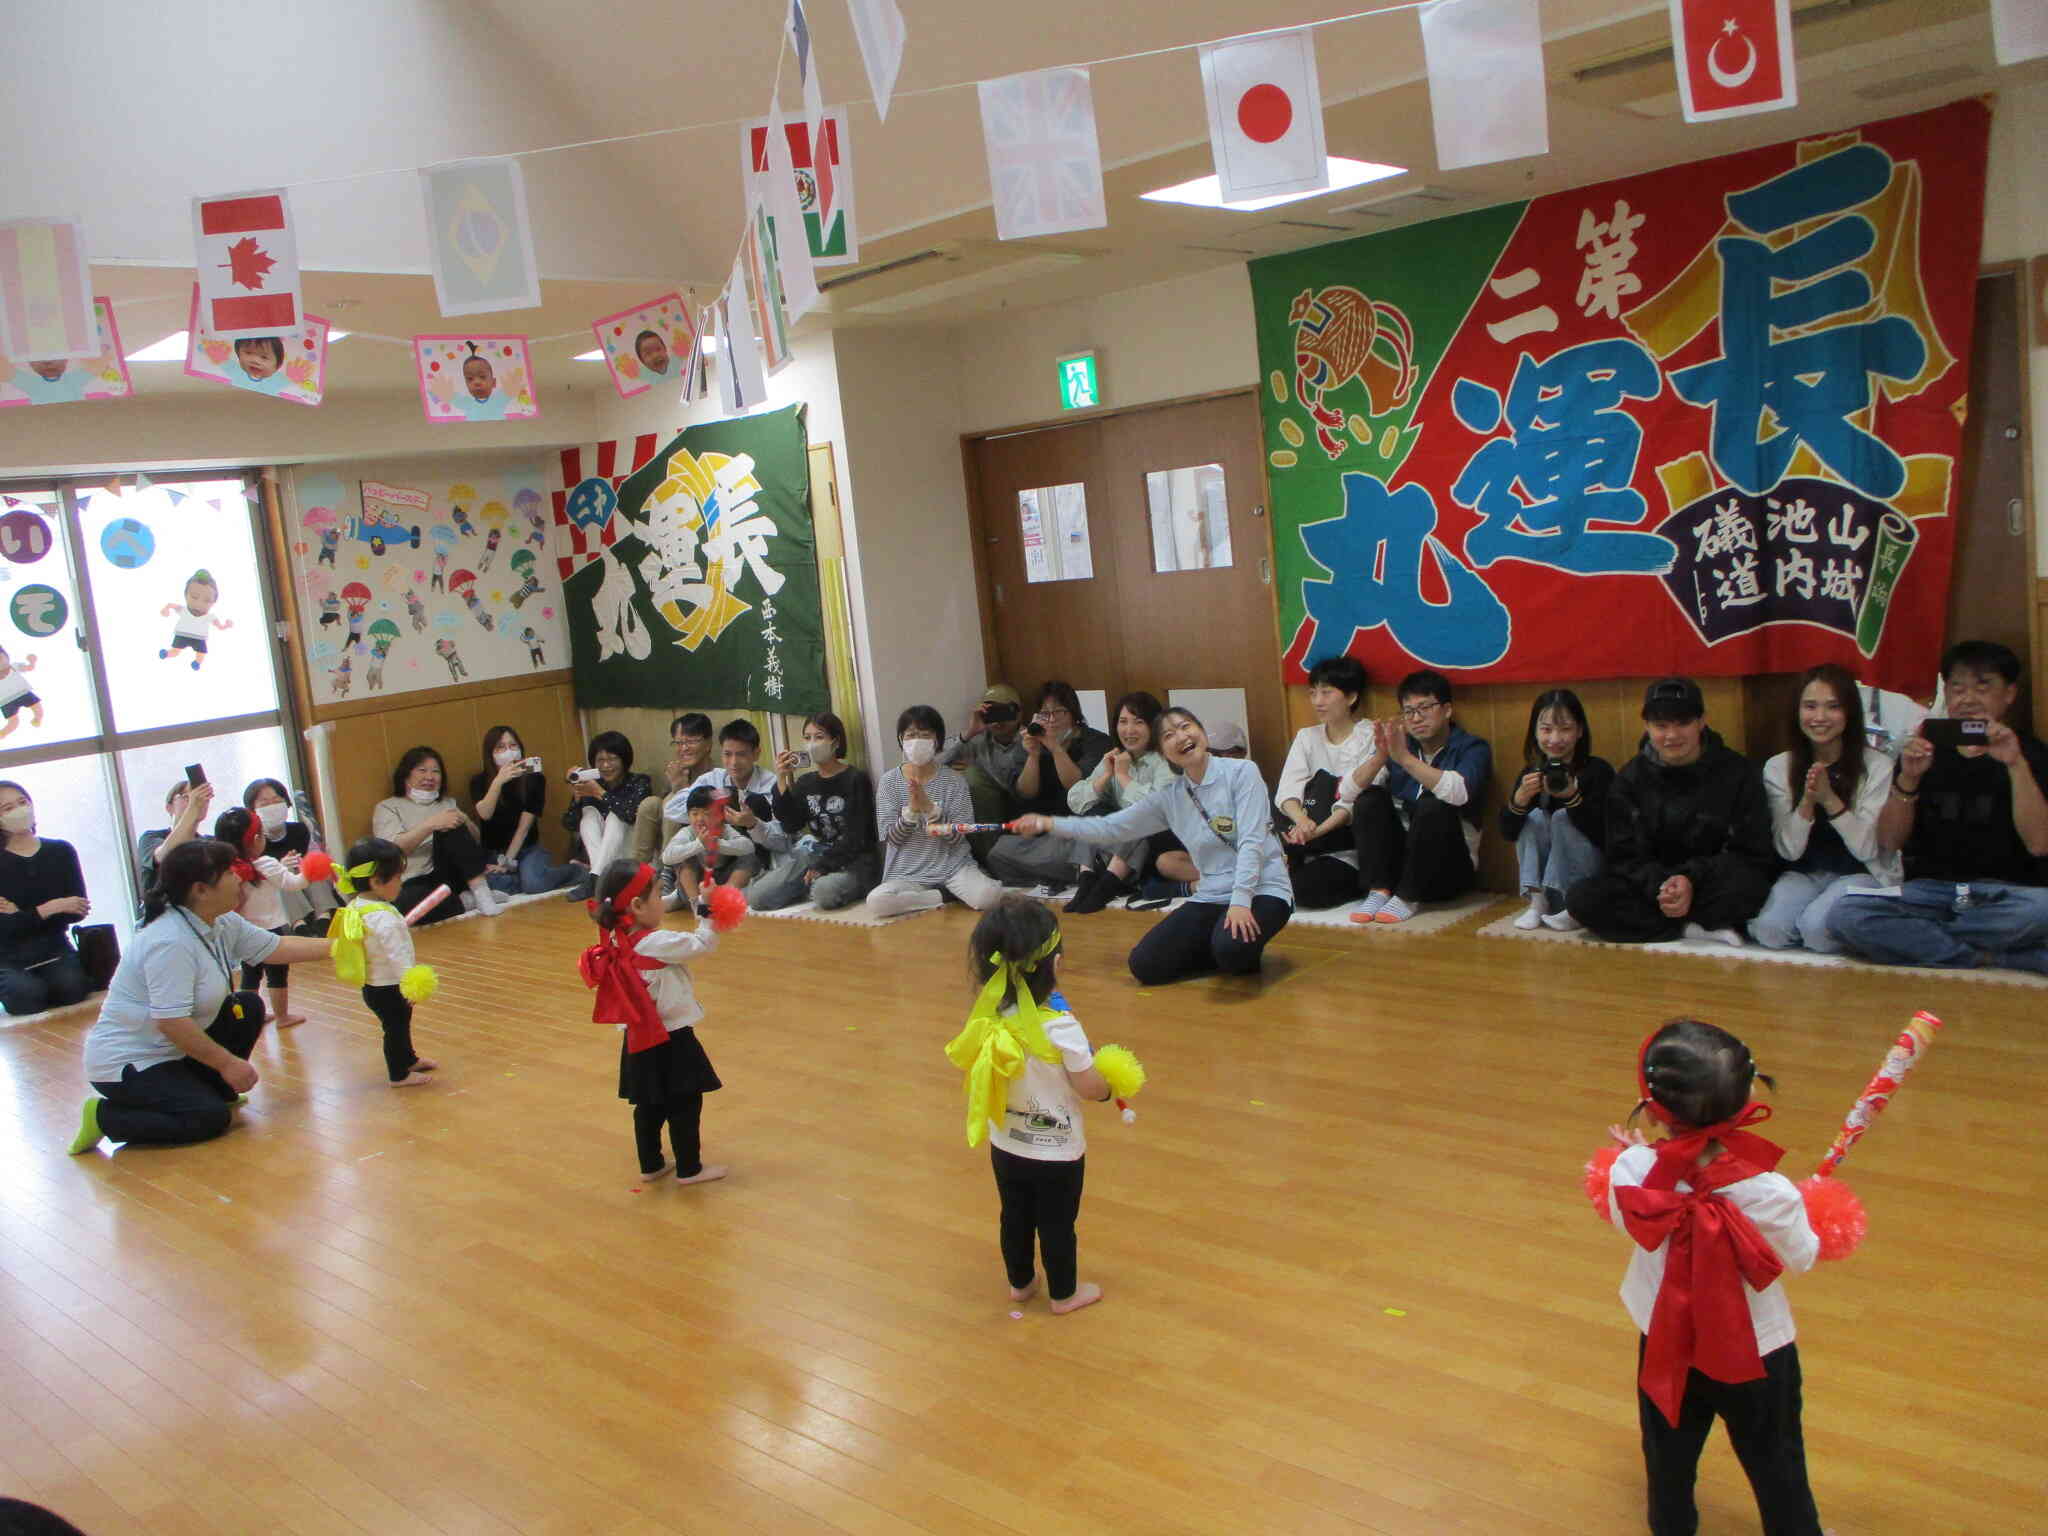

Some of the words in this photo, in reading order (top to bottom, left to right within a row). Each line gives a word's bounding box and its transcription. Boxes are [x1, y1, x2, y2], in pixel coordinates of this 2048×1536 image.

[1486, 200, 1646, 344] 第二
[1766, 498, 1818, 600] 池内
[1821, 503, 1870, 621] 山城
